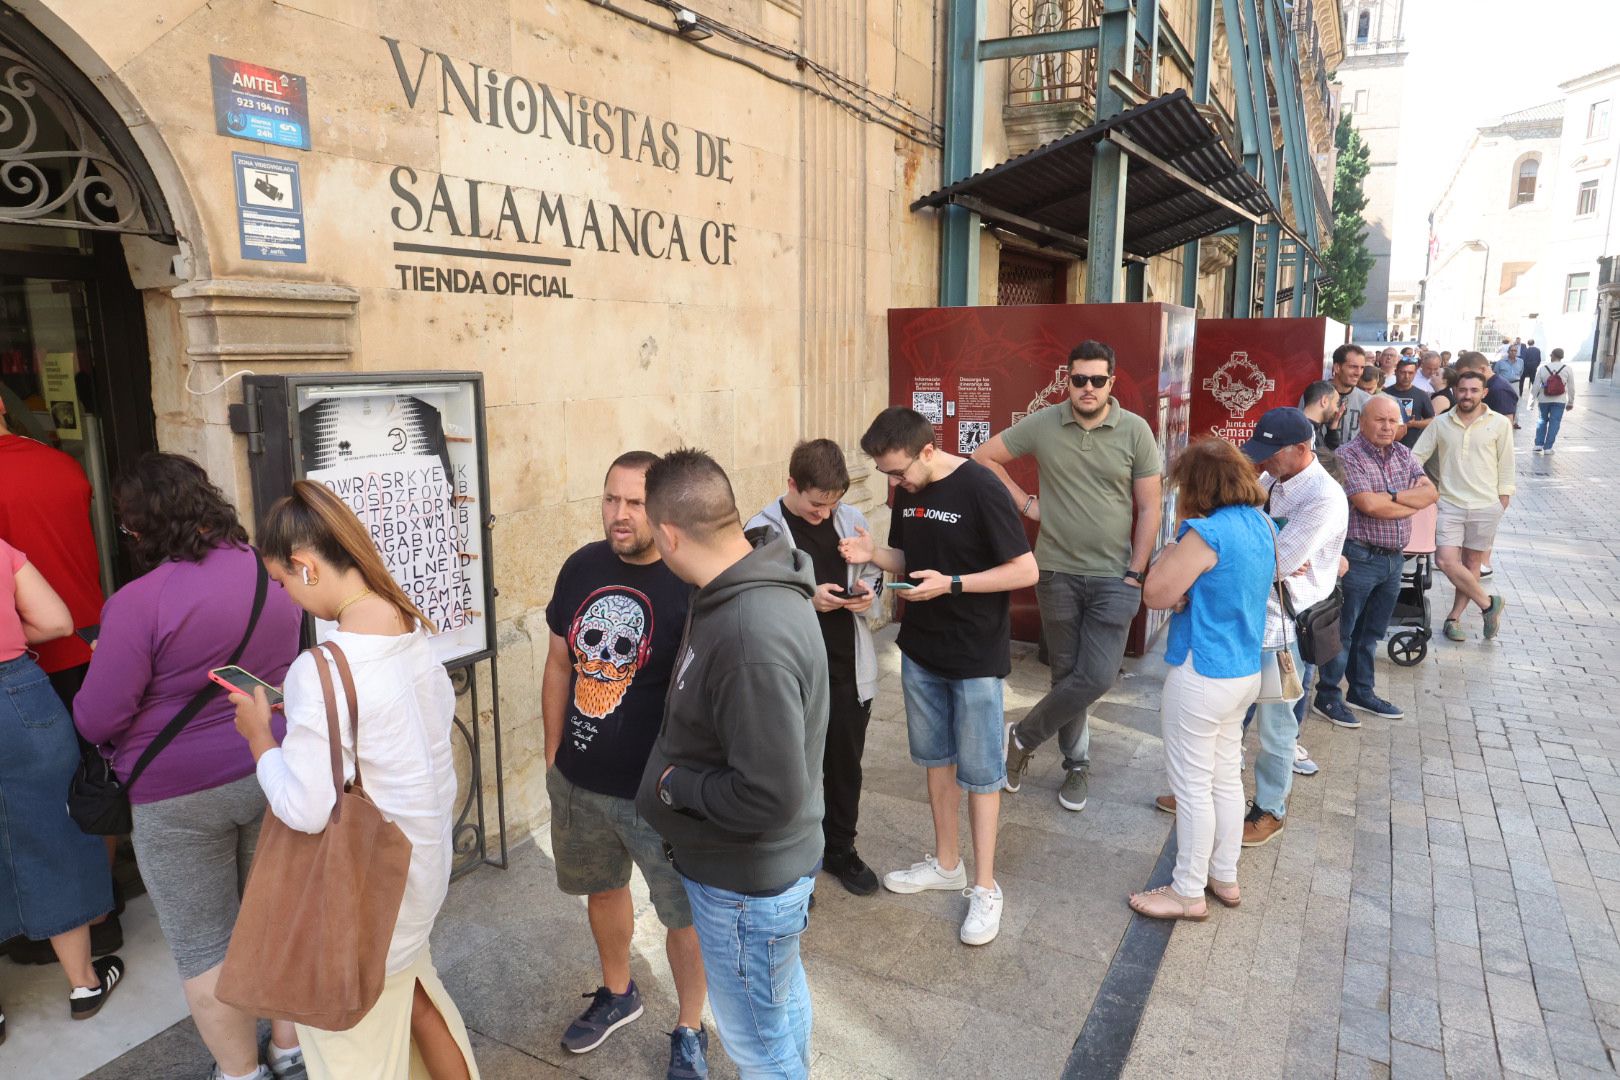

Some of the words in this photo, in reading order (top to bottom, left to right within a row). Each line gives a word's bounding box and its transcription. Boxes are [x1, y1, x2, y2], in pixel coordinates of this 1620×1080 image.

[232, 71, 282, 96] AMTEL
[236, 97, 254, 109] 923
[256, 101, 272, 113] 194
[274, 104, 289, 116] 011
[237, 158, 254, 167] ZONA
[695, 129, 734, 184] DE
[389, 165, 690, 262] SALAMANCA
[700, 219, 736, 266] CF
[395, 264, 487, 294] TIENDA
[492, 271, 574, 299] OFICIAL
[1210, 425, 1254, 438] Seman
[1225, 419, 1246, 429] Junta
[903, 507, 916, 518] ACK
